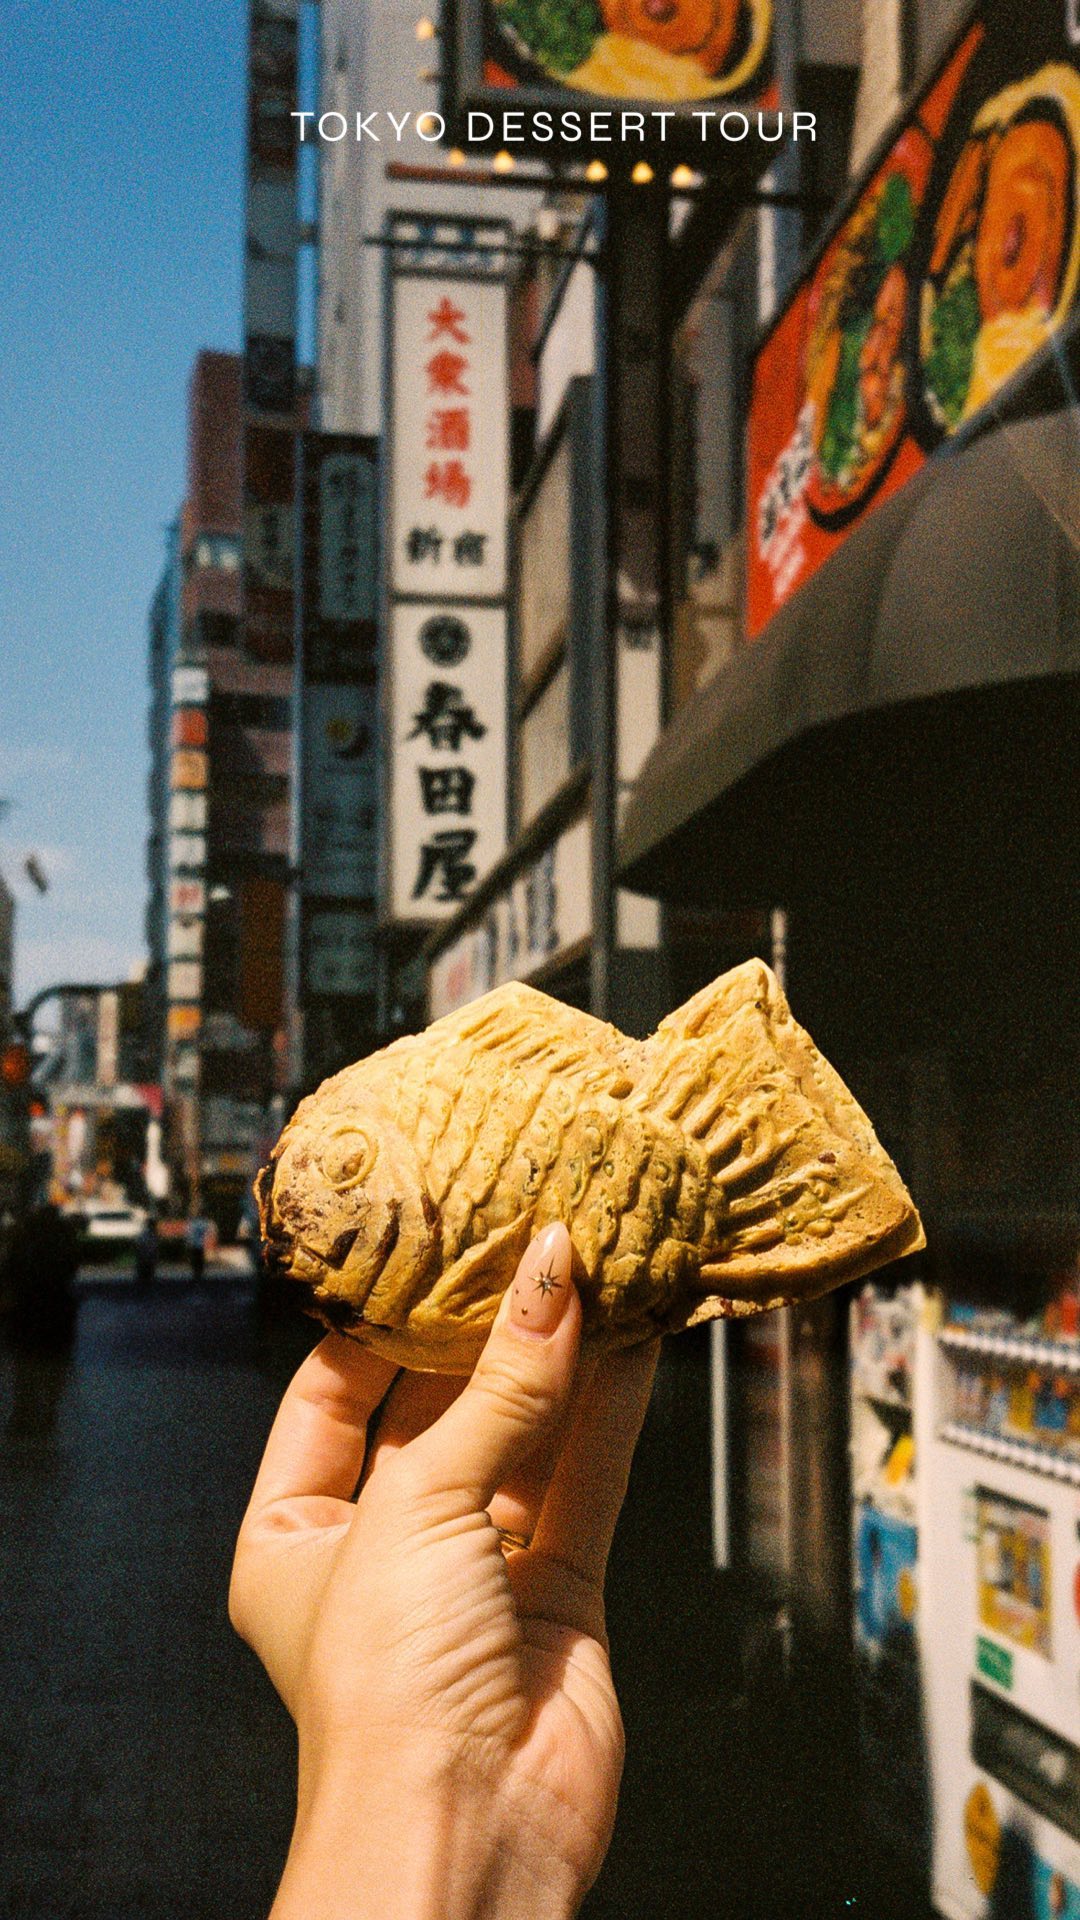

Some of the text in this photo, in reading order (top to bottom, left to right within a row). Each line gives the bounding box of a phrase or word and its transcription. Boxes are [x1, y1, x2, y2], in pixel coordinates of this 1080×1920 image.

[424, 296, 472, 509] 大衆酒場
[407, 680, 487, 902] 春田屋
